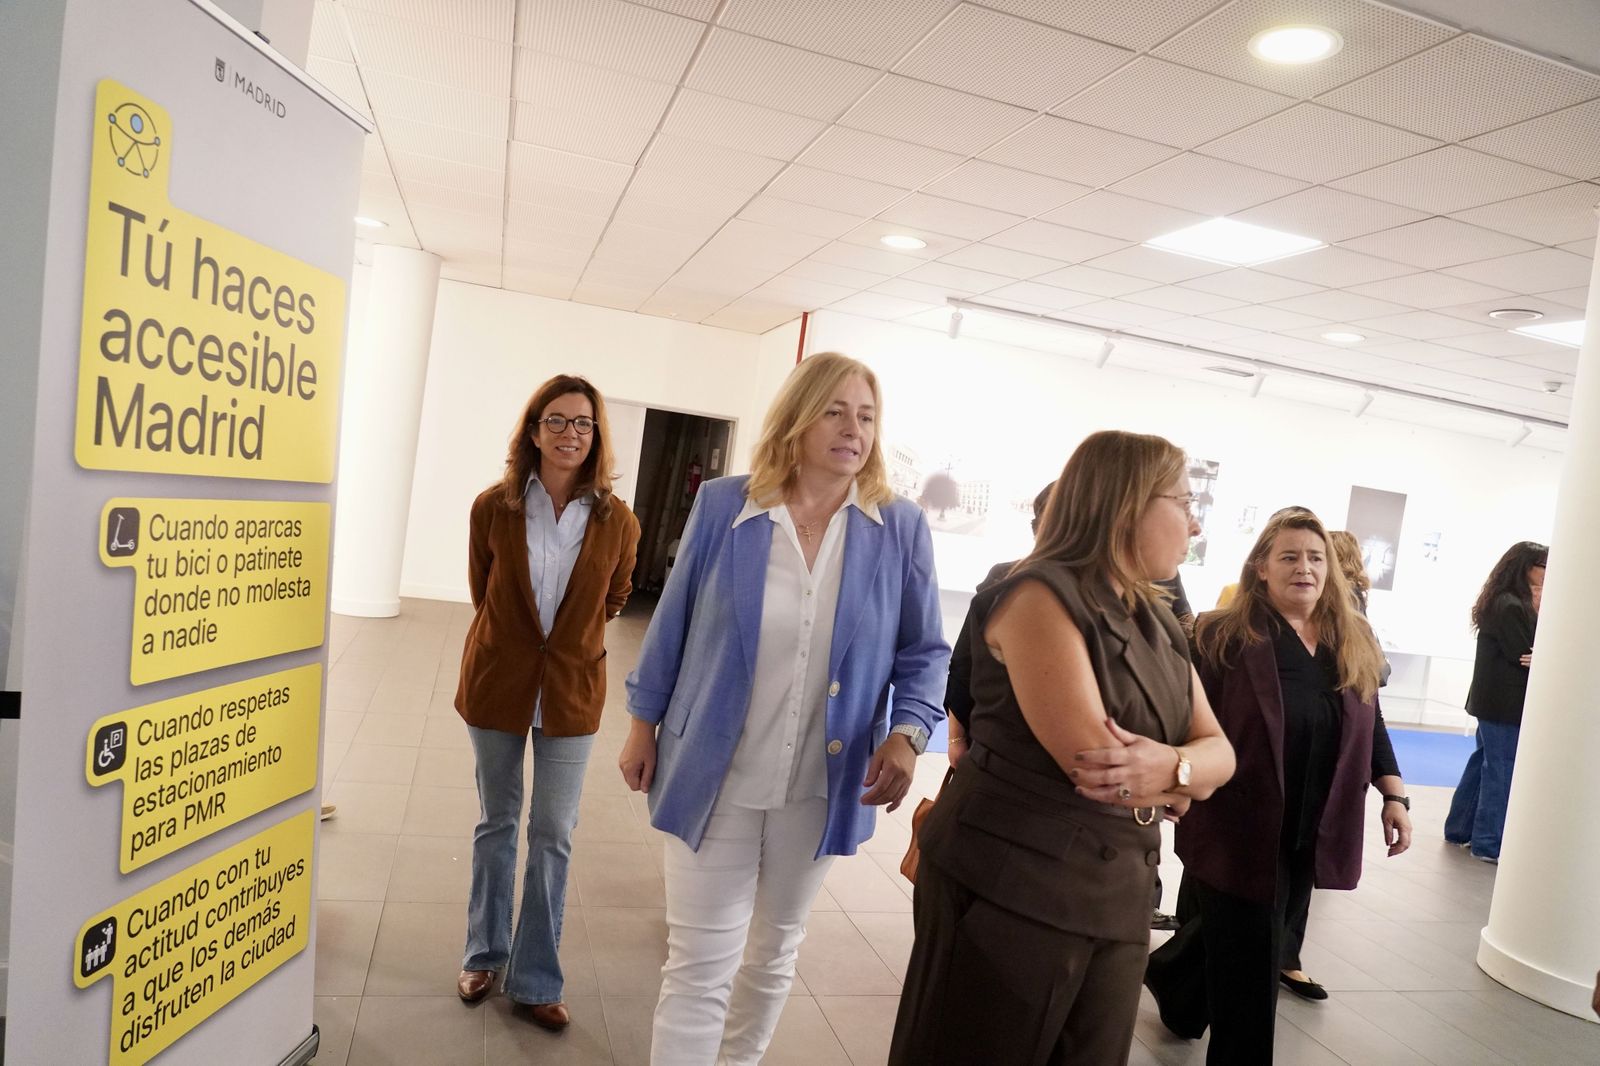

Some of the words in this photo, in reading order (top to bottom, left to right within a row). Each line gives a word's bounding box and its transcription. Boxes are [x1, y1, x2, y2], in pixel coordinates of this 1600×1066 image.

[235, 72, 287, 119] MADRID
[108, 201, 173, 291] Tú
[192, 237, 315, 335] haces
[100, 308, 317, 401] accesible
[94, 376, 265, 460] Madrid
[147, 553, 167, 579] tu
[175, 549, 211, 577] bici
[216, 557, 228, 573] o
[234, 546, 302, 578] patinete
[150, 514, 228, 541] Cuando
[235, 518, 302, 544] aparcas
[144, 585, 211, 617] donde
[217, 586, 240, 607] no
[246, 577, 311, 604] molesta
[142, 633, 154, 655] a
[162, 618, 217, 651] nadie
[137, 705, 213, 746] Cuando
[219, 686, 290, 722] respetas
[133, 745, 282, 817] estacionamiento
[135, 756, 163, 783] las
[170, 734, 230, 777] plazas
[235, 723, 256, 748] de
[130, 820, 177, 860] para
[184, 792, 226, 830] PMR
[124, 911, 199, 978] actitud
[205, 858, 304, 929] contribuyes
[127, 878, 209, 938] Cuando
[216, 858, 249, 890] con
[255, 847, 271, 870] tu
[120, 974, 213, 1053] disfruten
[220, 960, 235, 985] la
[241, 915, 296, 970] ciudad
[122, 991, 135, 1016] a
[143, 962, 184, 1005] que
[190, 939, 218, 972] los
[224, 899, 280, 950] demás
